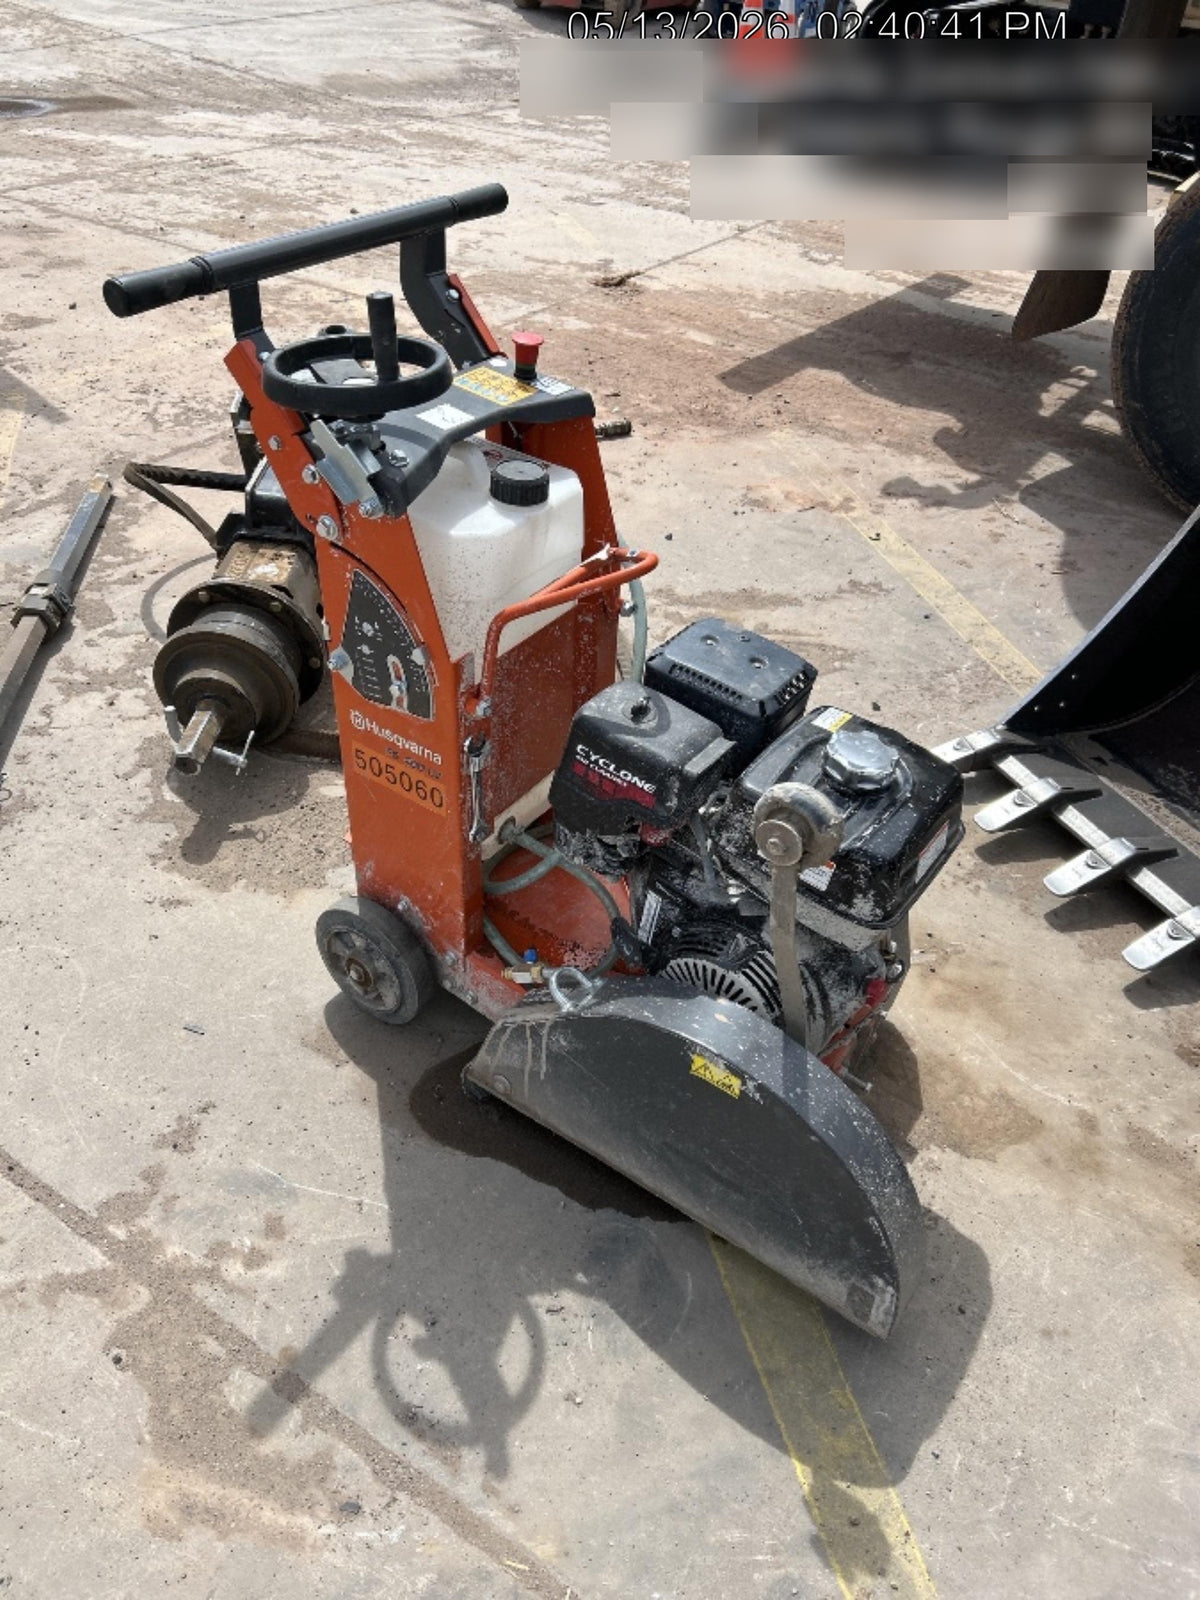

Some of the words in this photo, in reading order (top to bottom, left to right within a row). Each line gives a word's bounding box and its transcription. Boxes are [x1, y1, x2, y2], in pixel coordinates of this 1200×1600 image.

[365, 717, 442, 765] Husqvarna
[355, 748, 443, 808] 505060
[576, 744, 656, 793] CYCLONE
